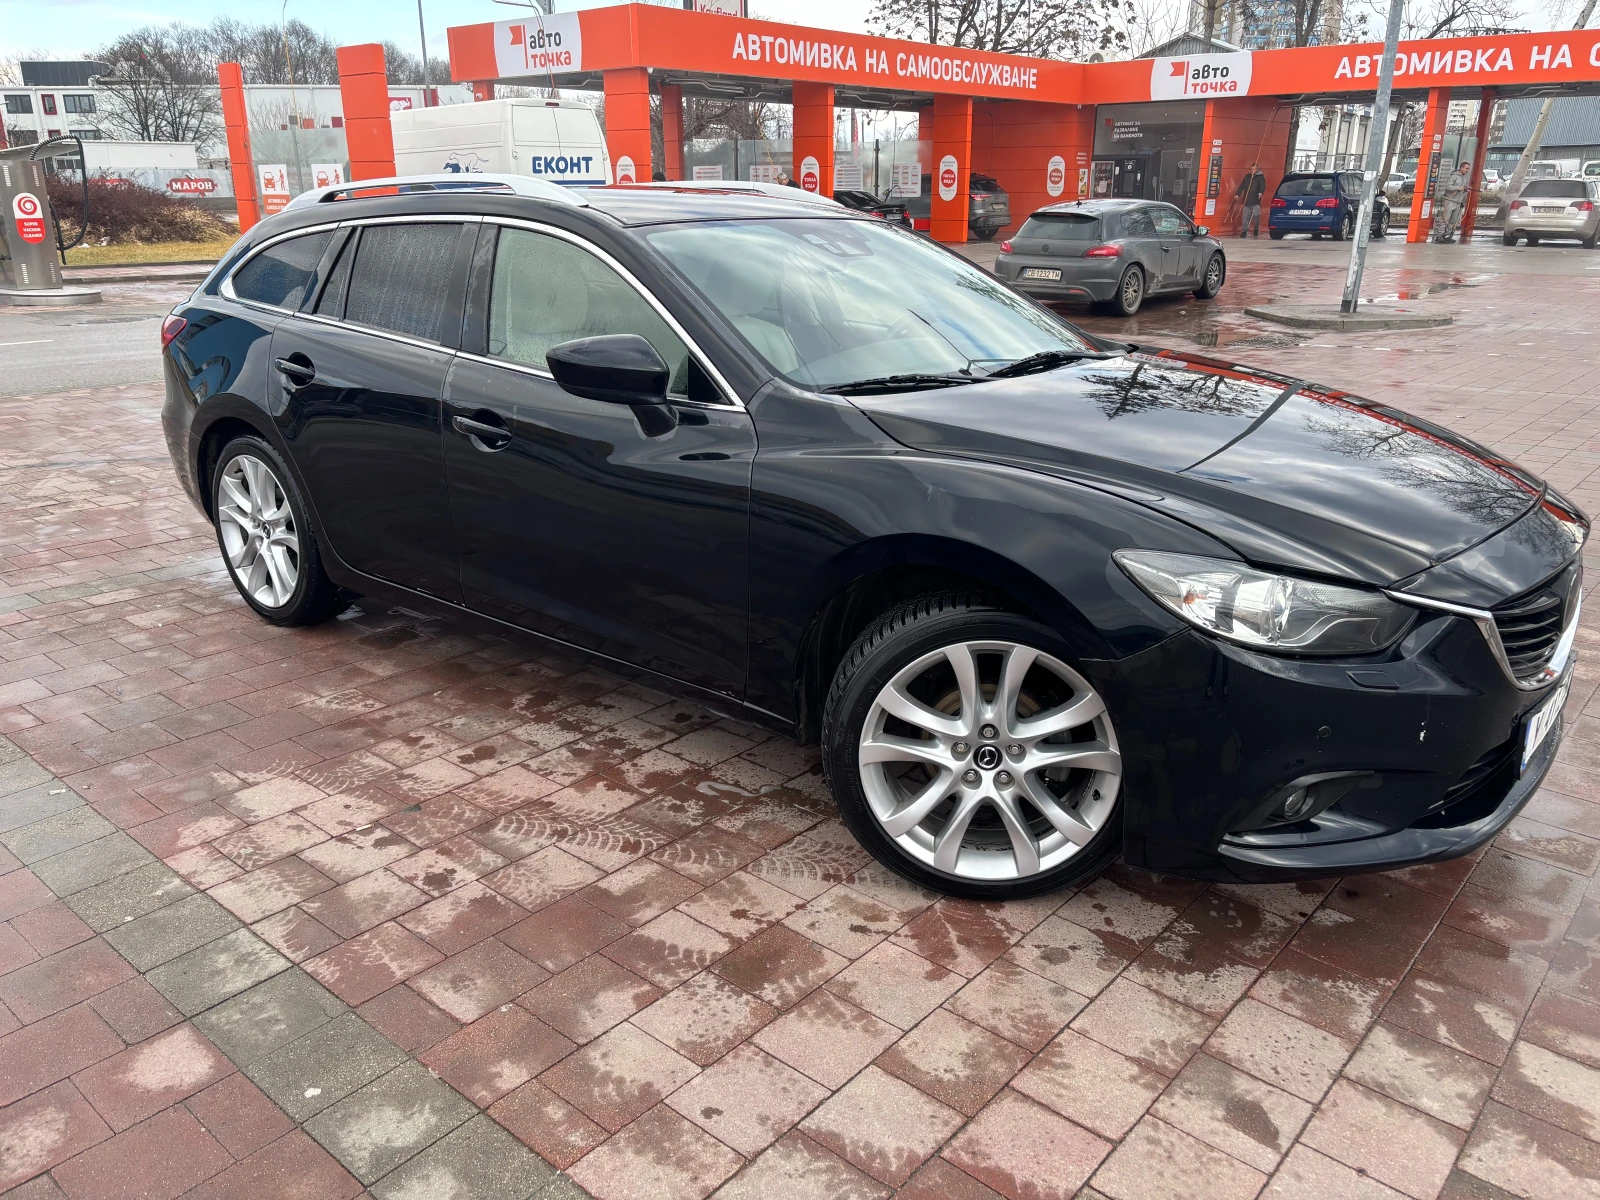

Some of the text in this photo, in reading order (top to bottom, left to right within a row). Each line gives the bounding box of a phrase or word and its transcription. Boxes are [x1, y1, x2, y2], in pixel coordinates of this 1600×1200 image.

[529, 28, 562, 50] авто
[530, 50, 572, 69] точка
[732, 32, 1038, 89] АВТОМИВКА НА САМООБСЛУЖВАНЕ
[1334, 47, 1514, 79] АВТОМИВКА
[1529, 43, 1573, 70] НА
[1191, 64, 1230, 80] авто
[1191, 80, 1238, 94] точка
[531, 156, 594, 174] ЕКОНТ
[172, 181, 213, 190] МАРОН
